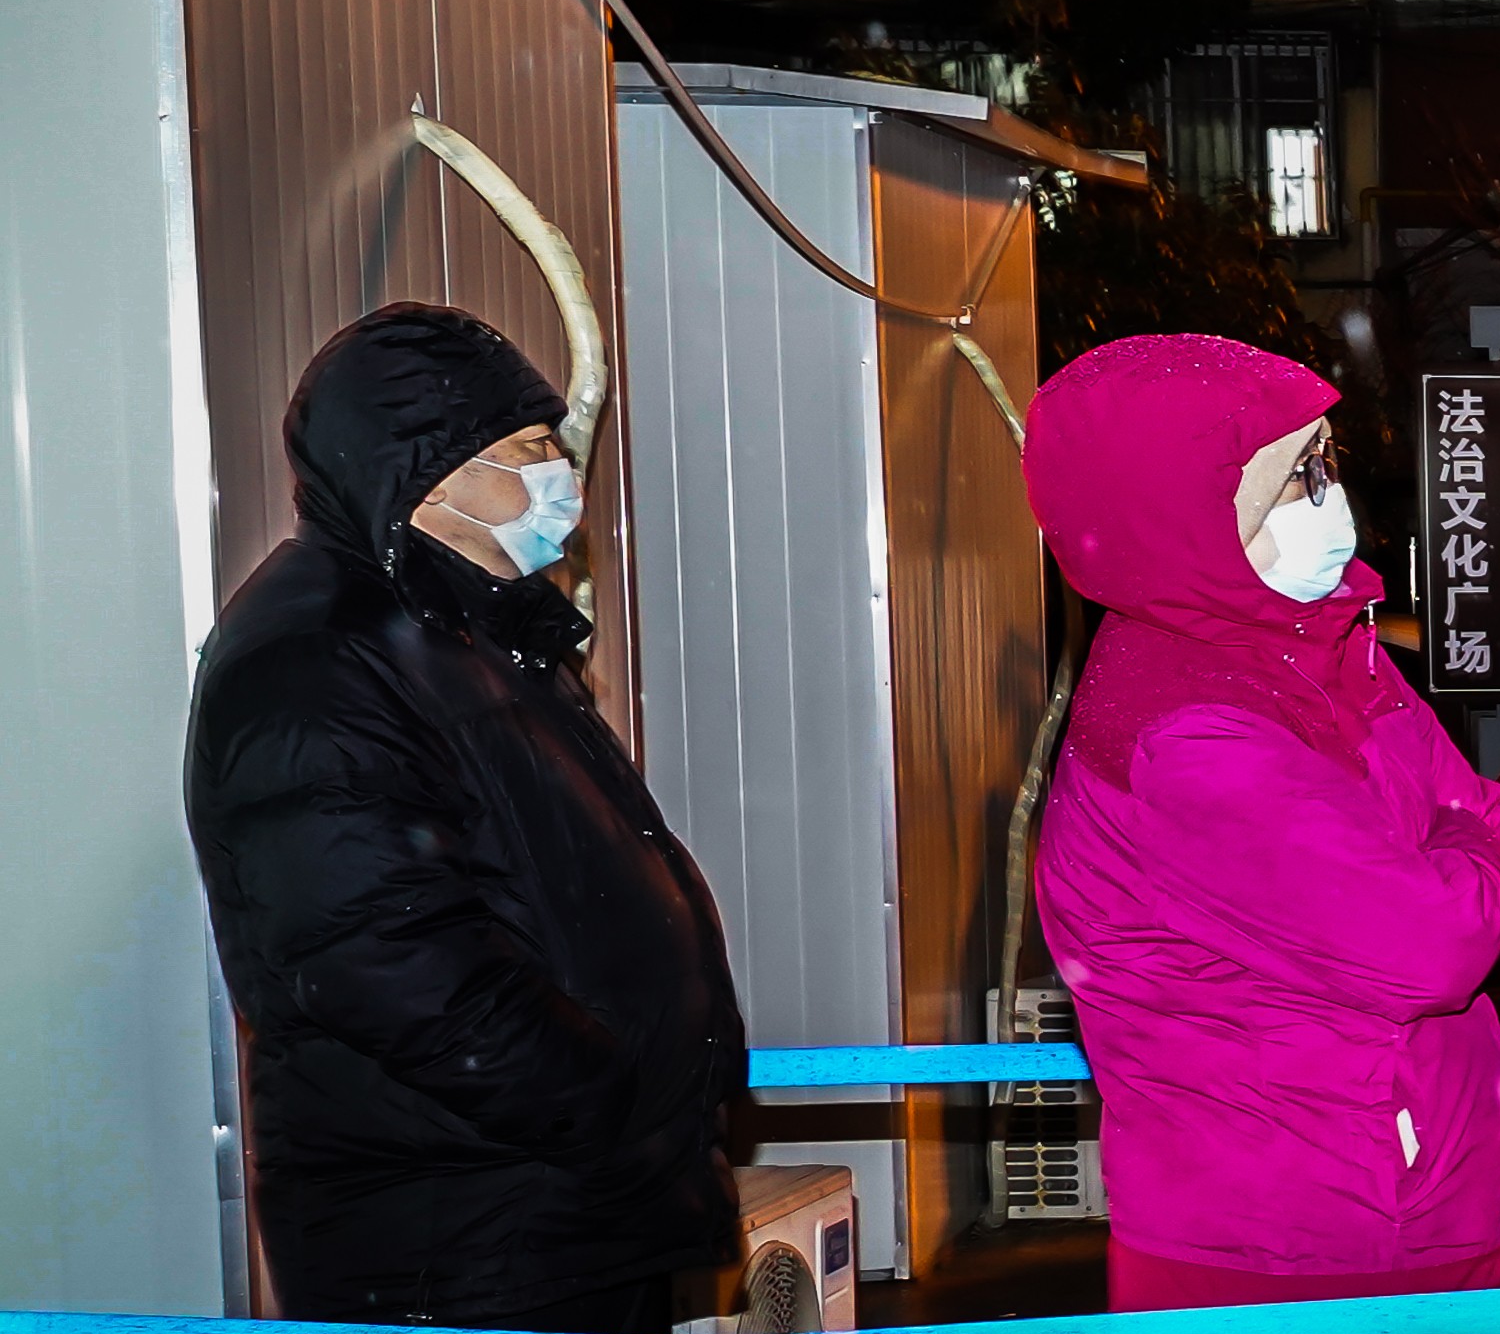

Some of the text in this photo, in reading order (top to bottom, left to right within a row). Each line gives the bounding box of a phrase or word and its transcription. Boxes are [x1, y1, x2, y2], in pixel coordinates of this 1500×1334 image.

[1437, 389, 1491, 675] 法治文化广场
